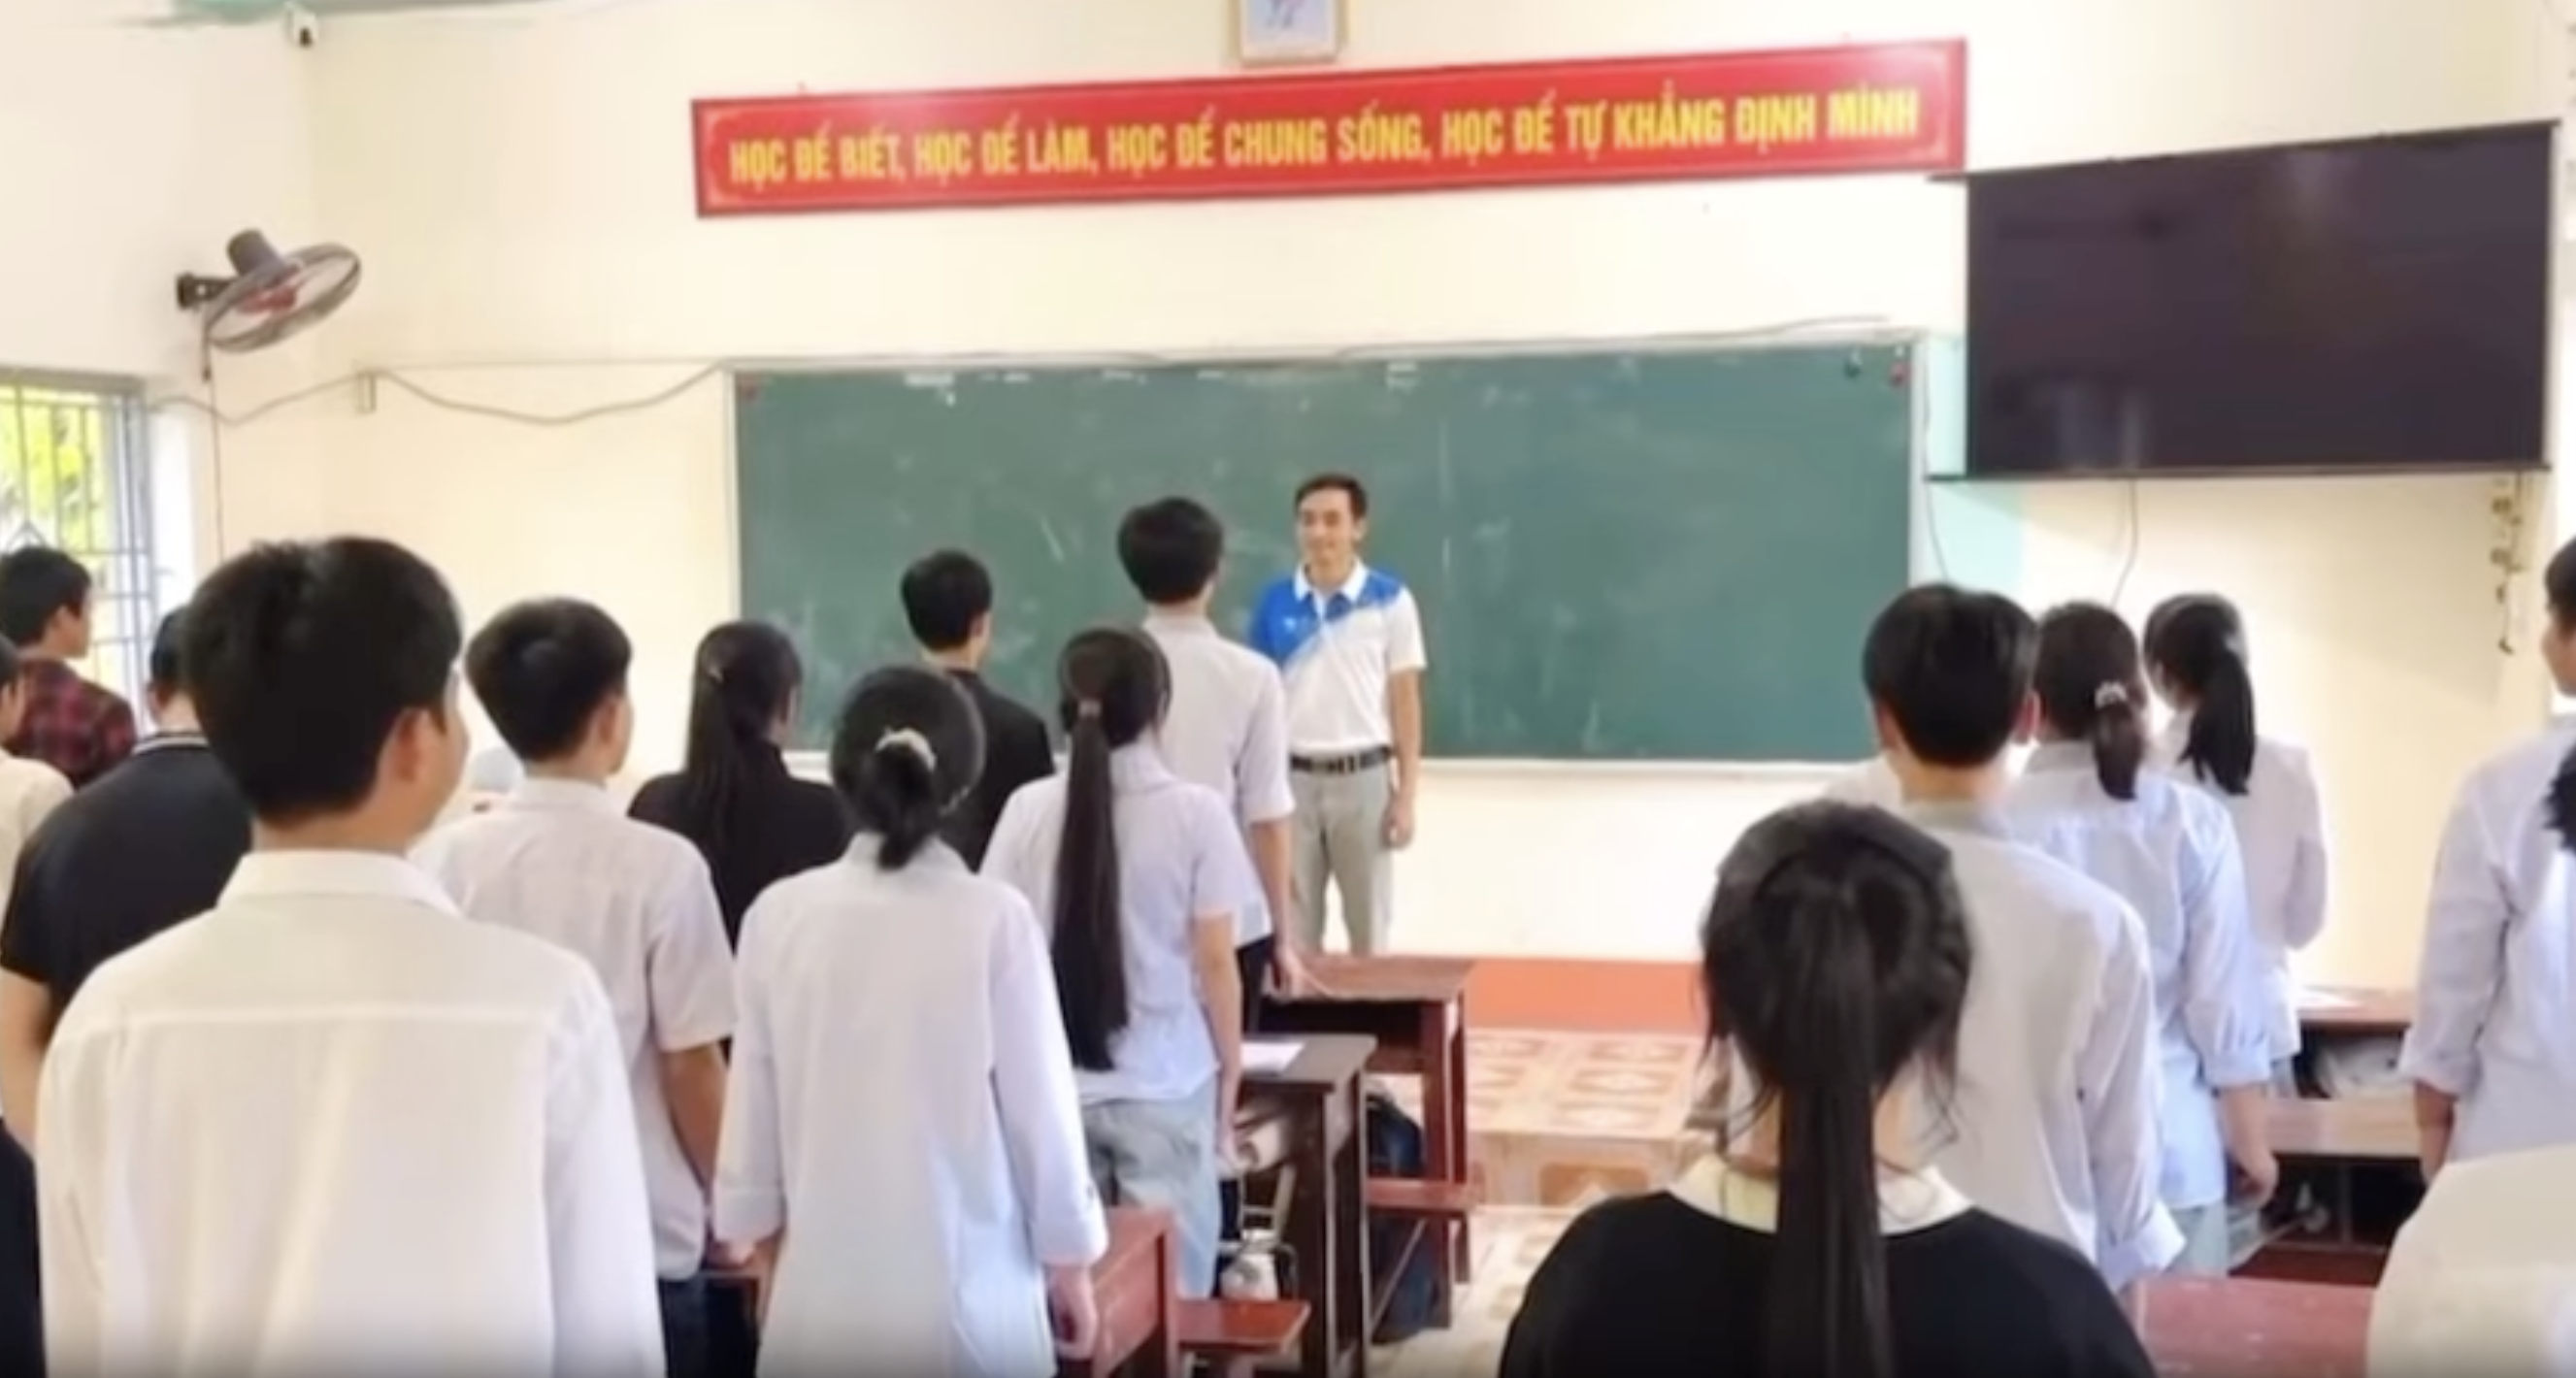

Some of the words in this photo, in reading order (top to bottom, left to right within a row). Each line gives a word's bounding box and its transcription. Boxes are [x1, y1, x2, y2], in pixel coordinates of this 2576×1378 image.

[729, 135, 788, 190] HỌC
[913, 126, 973, 185] HỌC
[1106, 123, 1167, 179] HỌC
[1222, 117, 1328, 170] CHUNG
[1440, 109, 1503, 167] HỌC
[1565, 101, 1607, 163] TỰ
